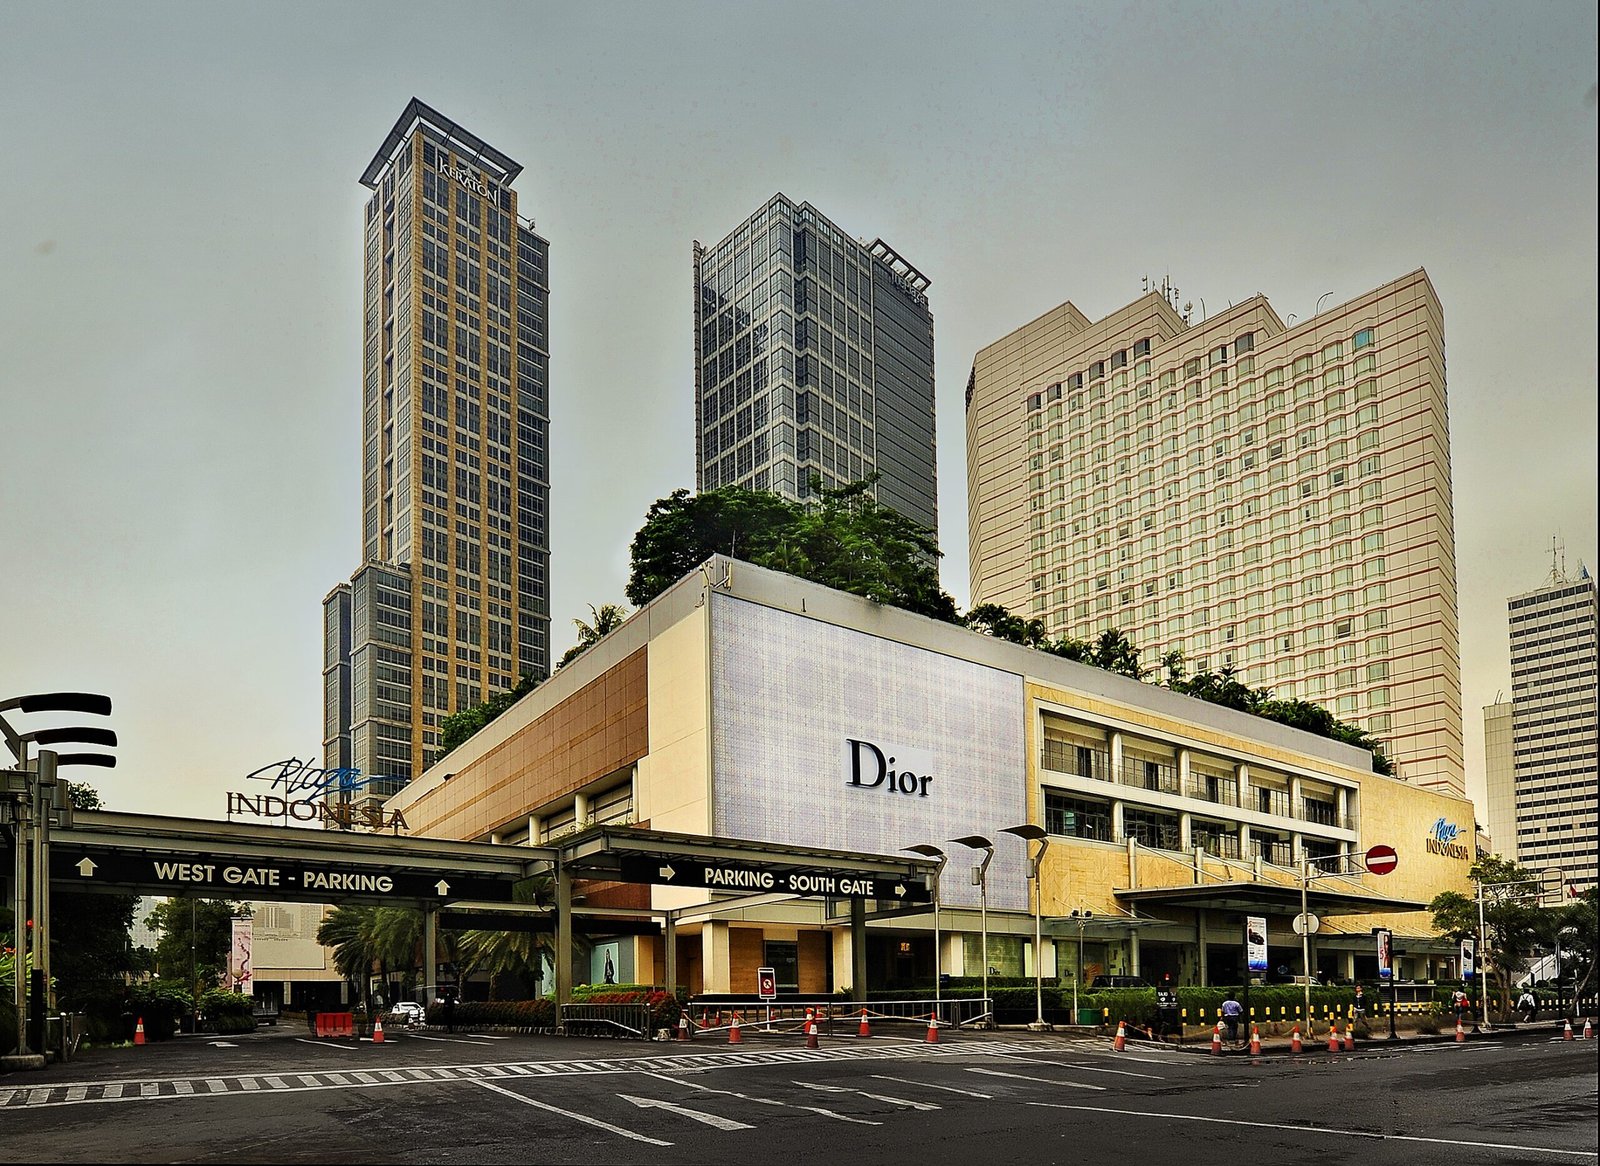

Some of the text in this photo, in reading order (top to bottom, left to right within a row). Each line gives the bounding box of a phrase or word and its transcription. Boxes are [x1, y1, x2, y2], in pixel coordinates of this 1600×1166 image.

[439, 155, 498, 207] KERATON
[246, 756, 408, 805] Plaza
[845, 738, 933, 797] Dior
[225, 791, 410, 830] INDONESIA
[1426, 837, 1469, 861] INDONESIA
[153, 861, 215, 883] WEST
[223, 865, 281, 887] GATE
[303, 871, 394, 893] PARKING
[704, 867, 775, 890] PARKING
[789, 875, 836, 893] SOUTH
[840, 879, 875, 896] GATE
